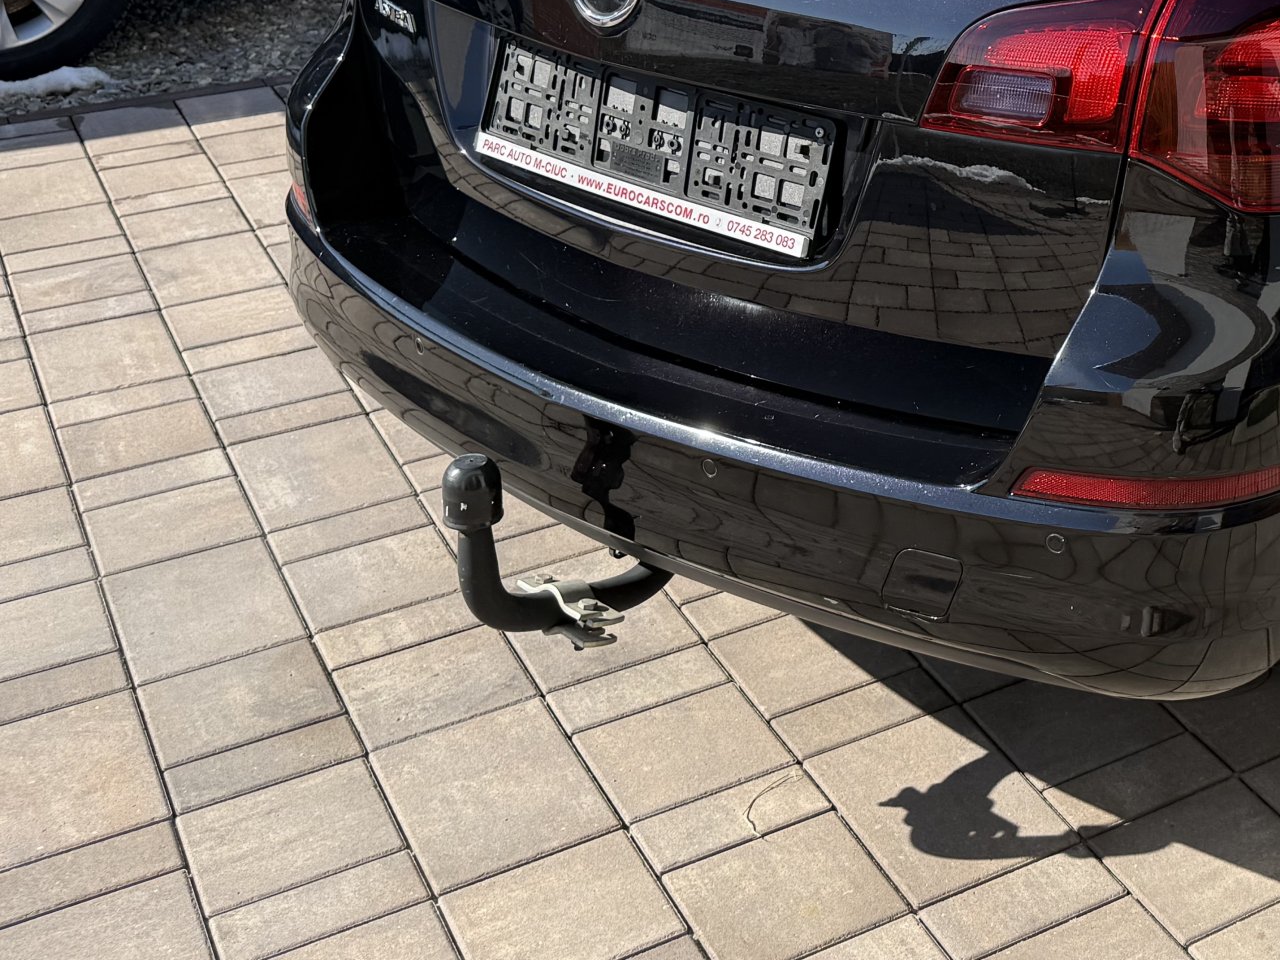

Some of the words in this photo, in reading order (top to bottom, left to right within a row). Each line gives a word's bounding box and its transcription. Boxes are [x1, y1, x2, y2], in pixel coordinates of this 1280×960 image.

[482, 139, 507, 157] PARC
[506, 146, 532, 166] AUTO
[533, 157, 568, 179] M-CIUC
[577, 173, 710, 225] www.EUROCARSCOM.ro
[726, 220, 752, 238] 0745
[754, 228, 774, 244] 283
[775, 234, 796, 250] 083
